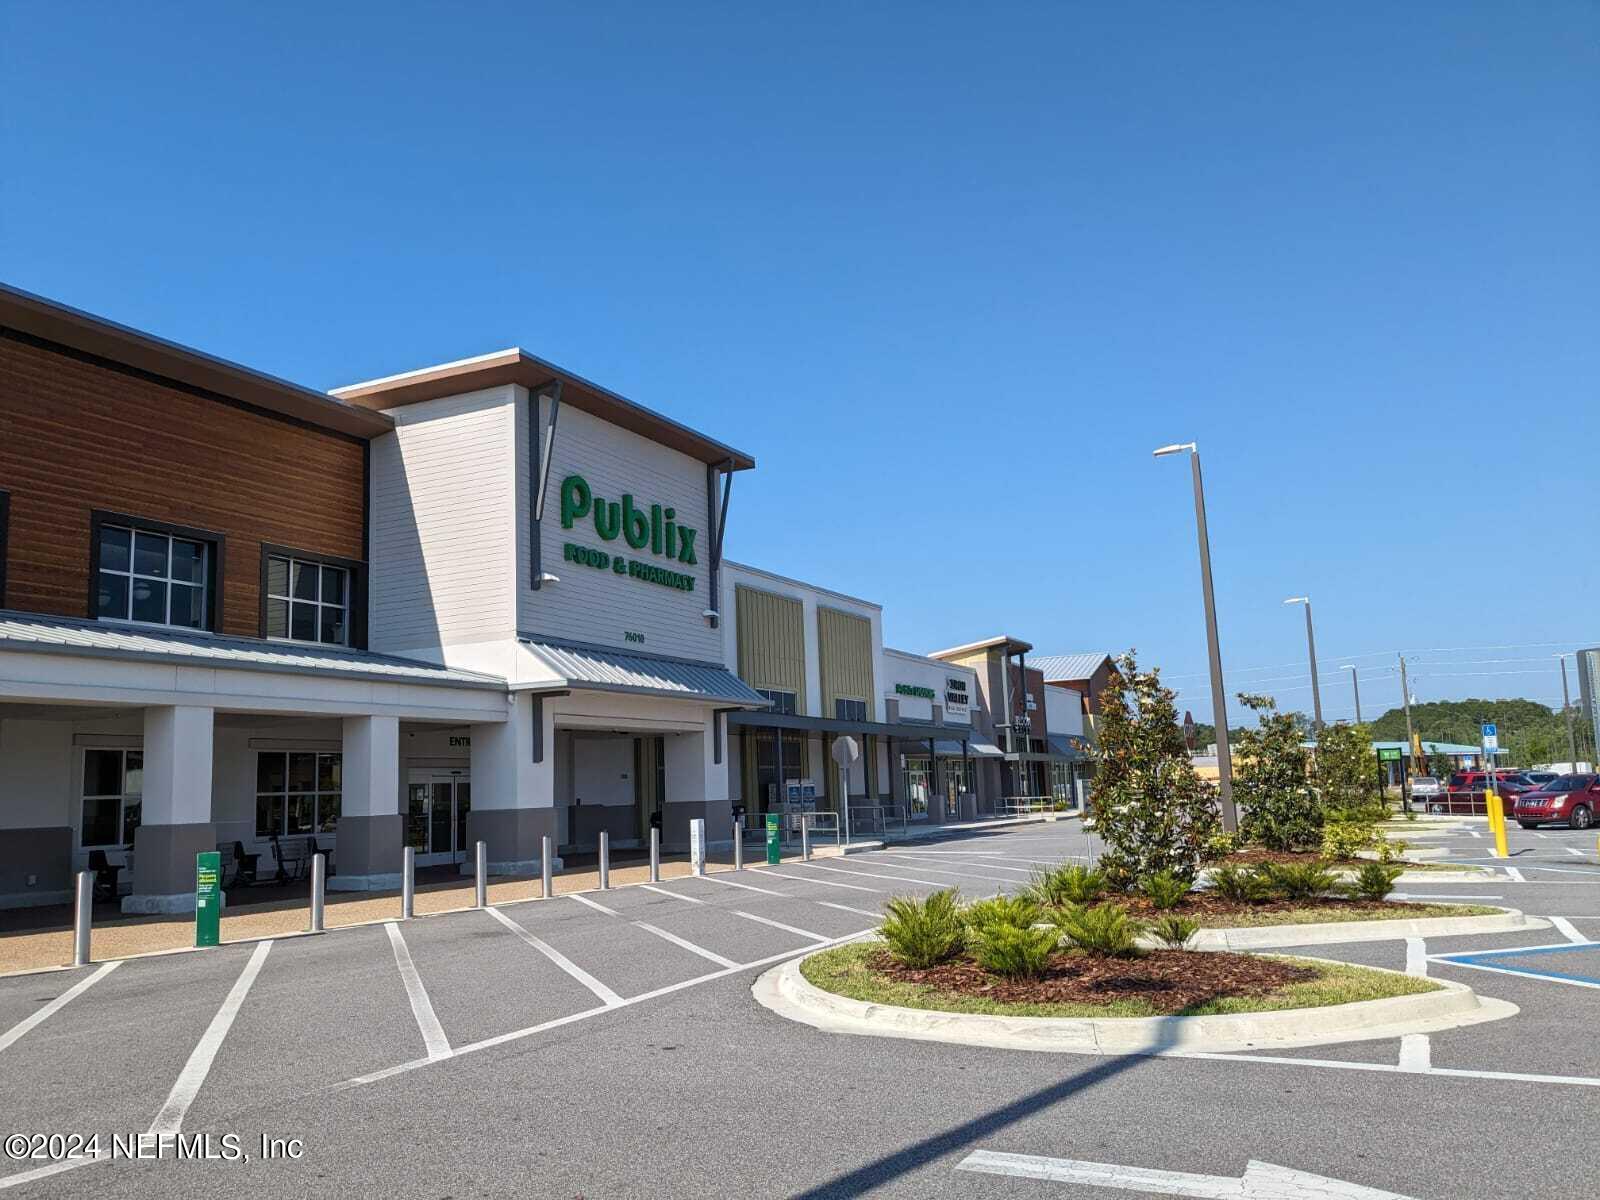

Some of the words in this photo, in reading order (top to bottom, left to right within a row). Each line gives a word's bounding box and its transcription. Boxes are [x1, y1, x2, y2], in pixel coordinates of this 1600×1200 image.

[560, 475, 697, 564] Publix
[563, 543, 610, 570] FOOD
[612, 556, 627, 574] &
[629, 560, 696, 591] PHARMACY
